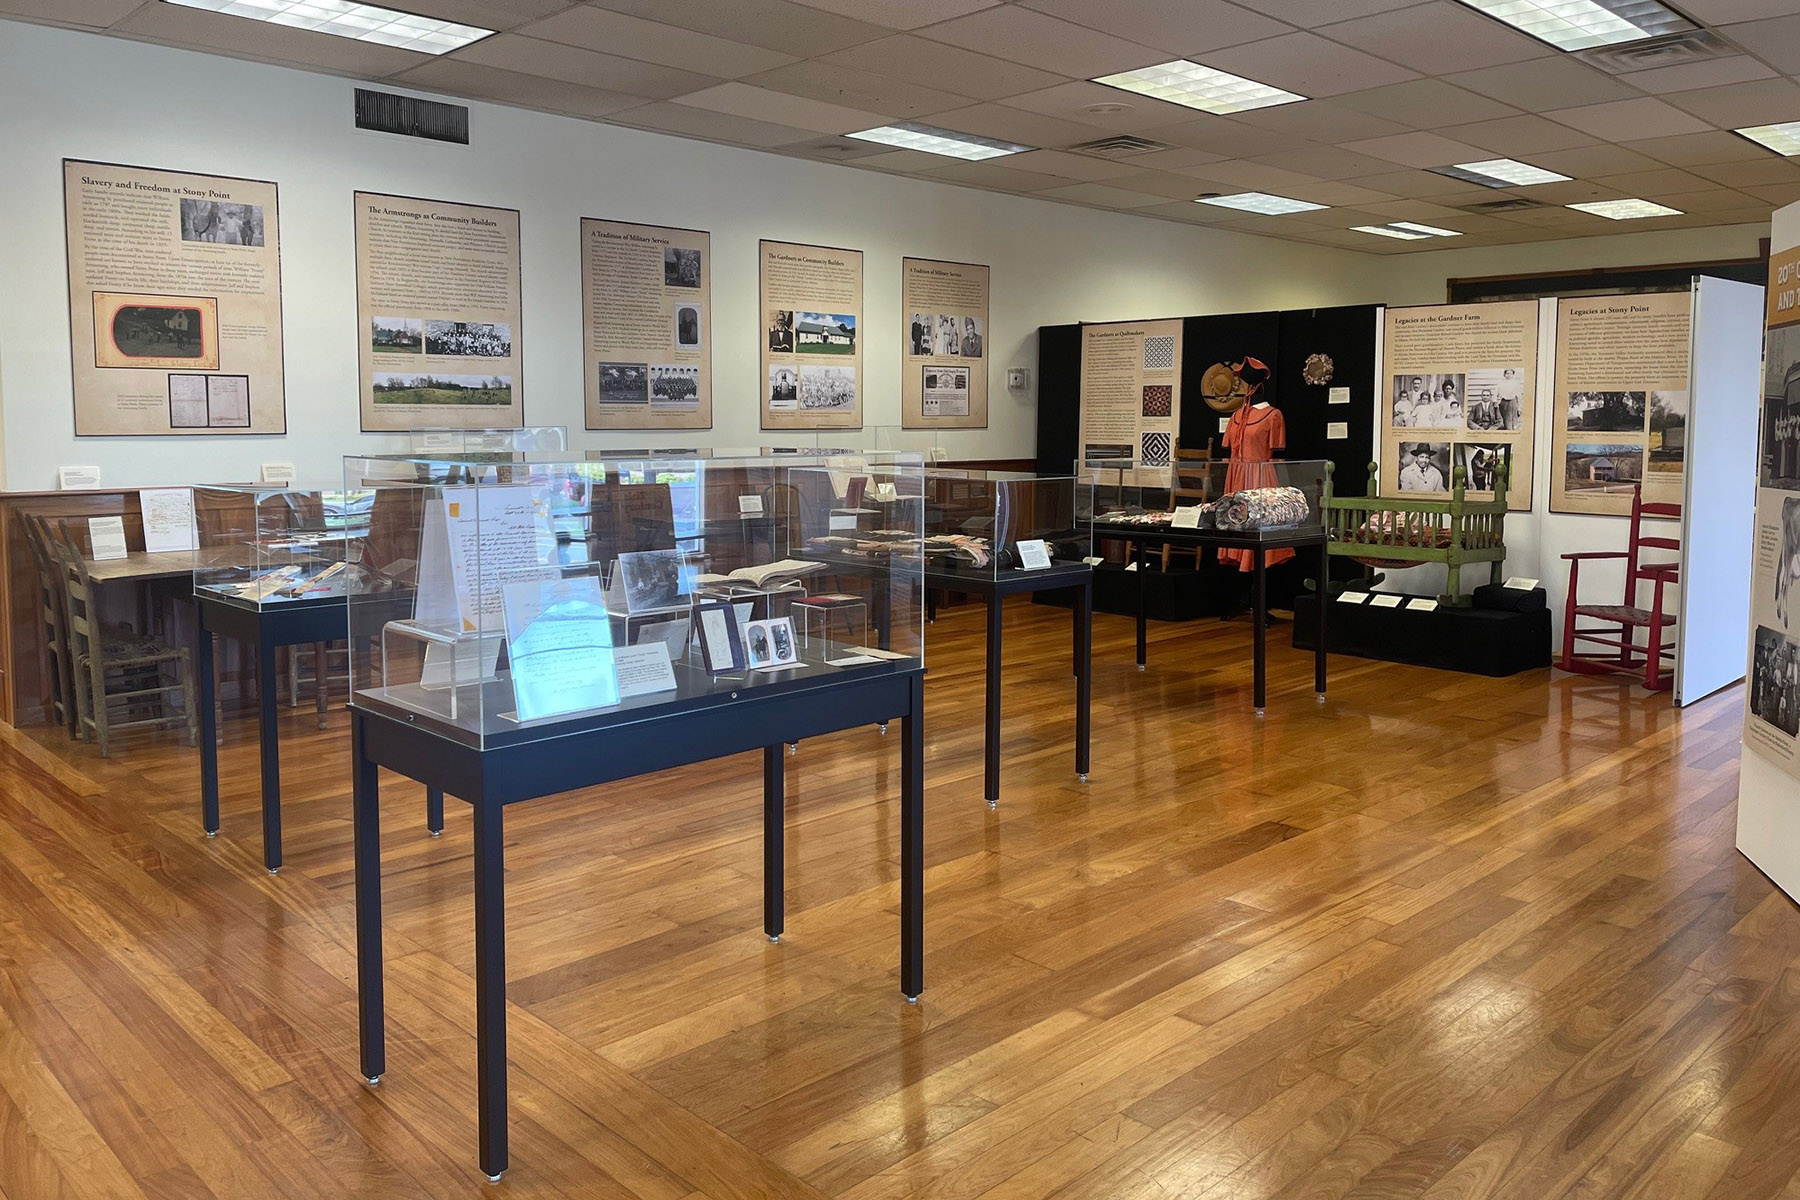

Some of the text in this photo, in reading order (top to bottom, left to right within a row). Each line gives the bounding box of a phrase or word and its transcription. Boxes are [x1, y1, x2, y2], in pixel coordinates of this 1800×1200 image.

[81, 176, 112, 188] Slavery
[116, 181, 131, 189] and
[134, 183, 170, 193] Freedom
[183, 188, 207, 198] Stony
[209, 190, 230, 199] Point
[368, 206, 381, 214] The
[383, 208, 421, 220] Armstrongs
[431, 214, 470, 224] Community
[472, 218, 496, 226] Builders
[777, 254, 796, 262] Gardners
[803, 257, 826, 265] Community
[1778, 290, 1795, 311] AND
[1608, 307, 1628, 315] Stony
[1395, 317, 1418, 325] Legacies
